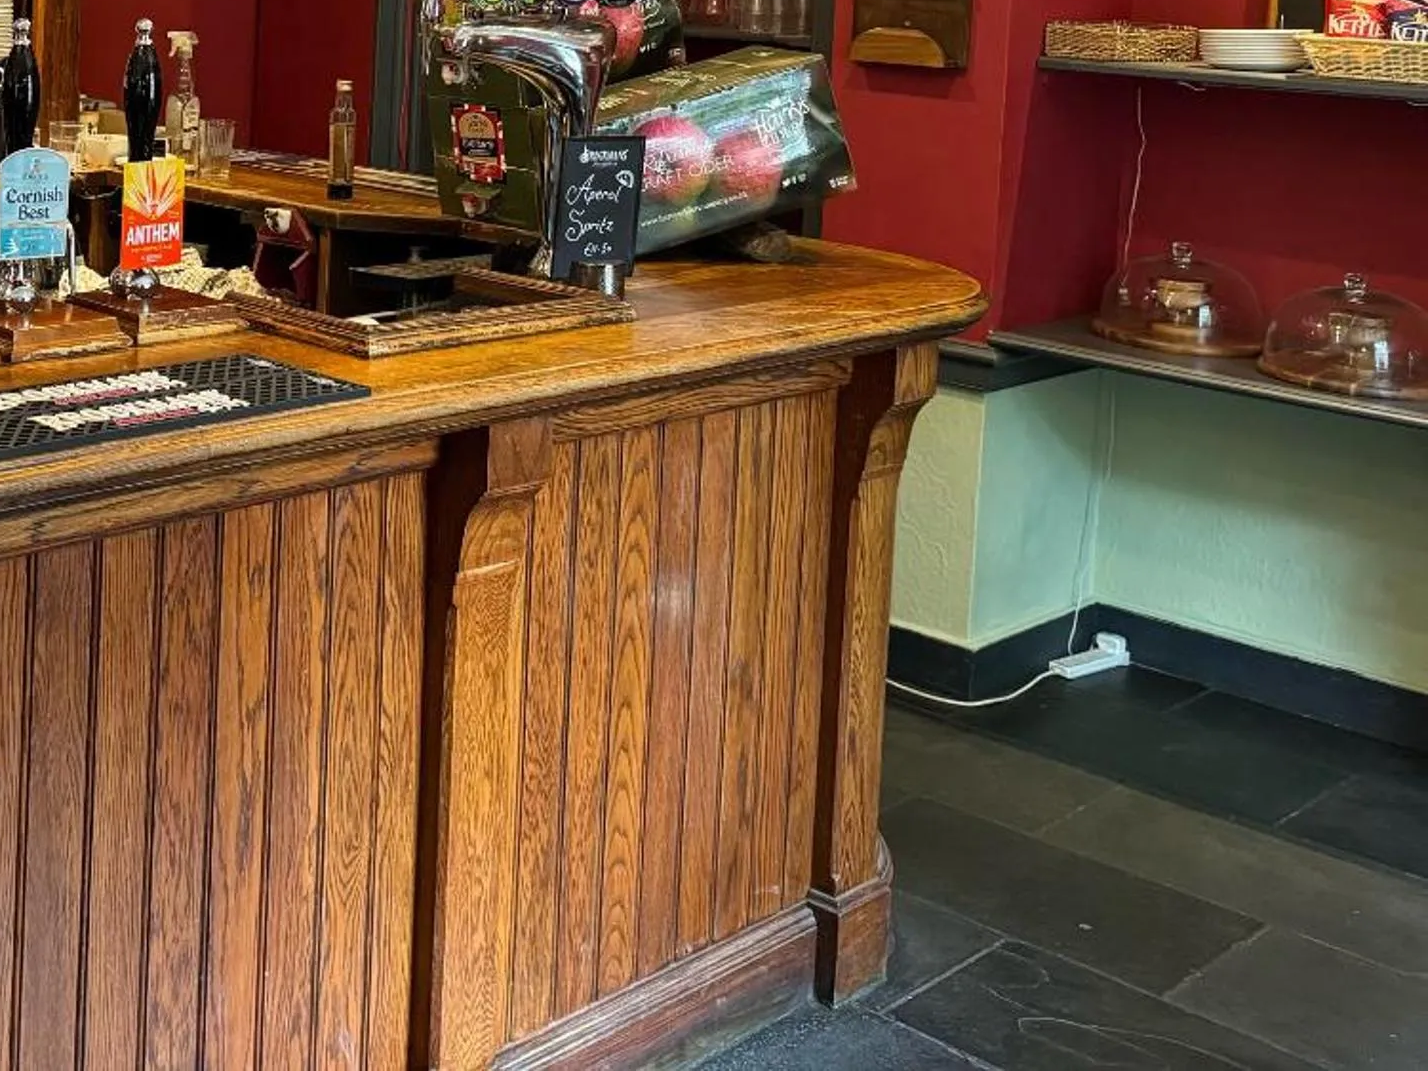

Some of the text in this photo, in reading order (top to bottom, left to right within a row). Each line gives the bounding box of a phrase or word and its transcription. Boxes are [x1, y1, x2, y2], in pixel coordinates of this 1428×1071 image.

[6, 185, 64, 204] Cornish
[18, 204, 50, 221] Best
[125, 220, 180, 246] ANTHEM
